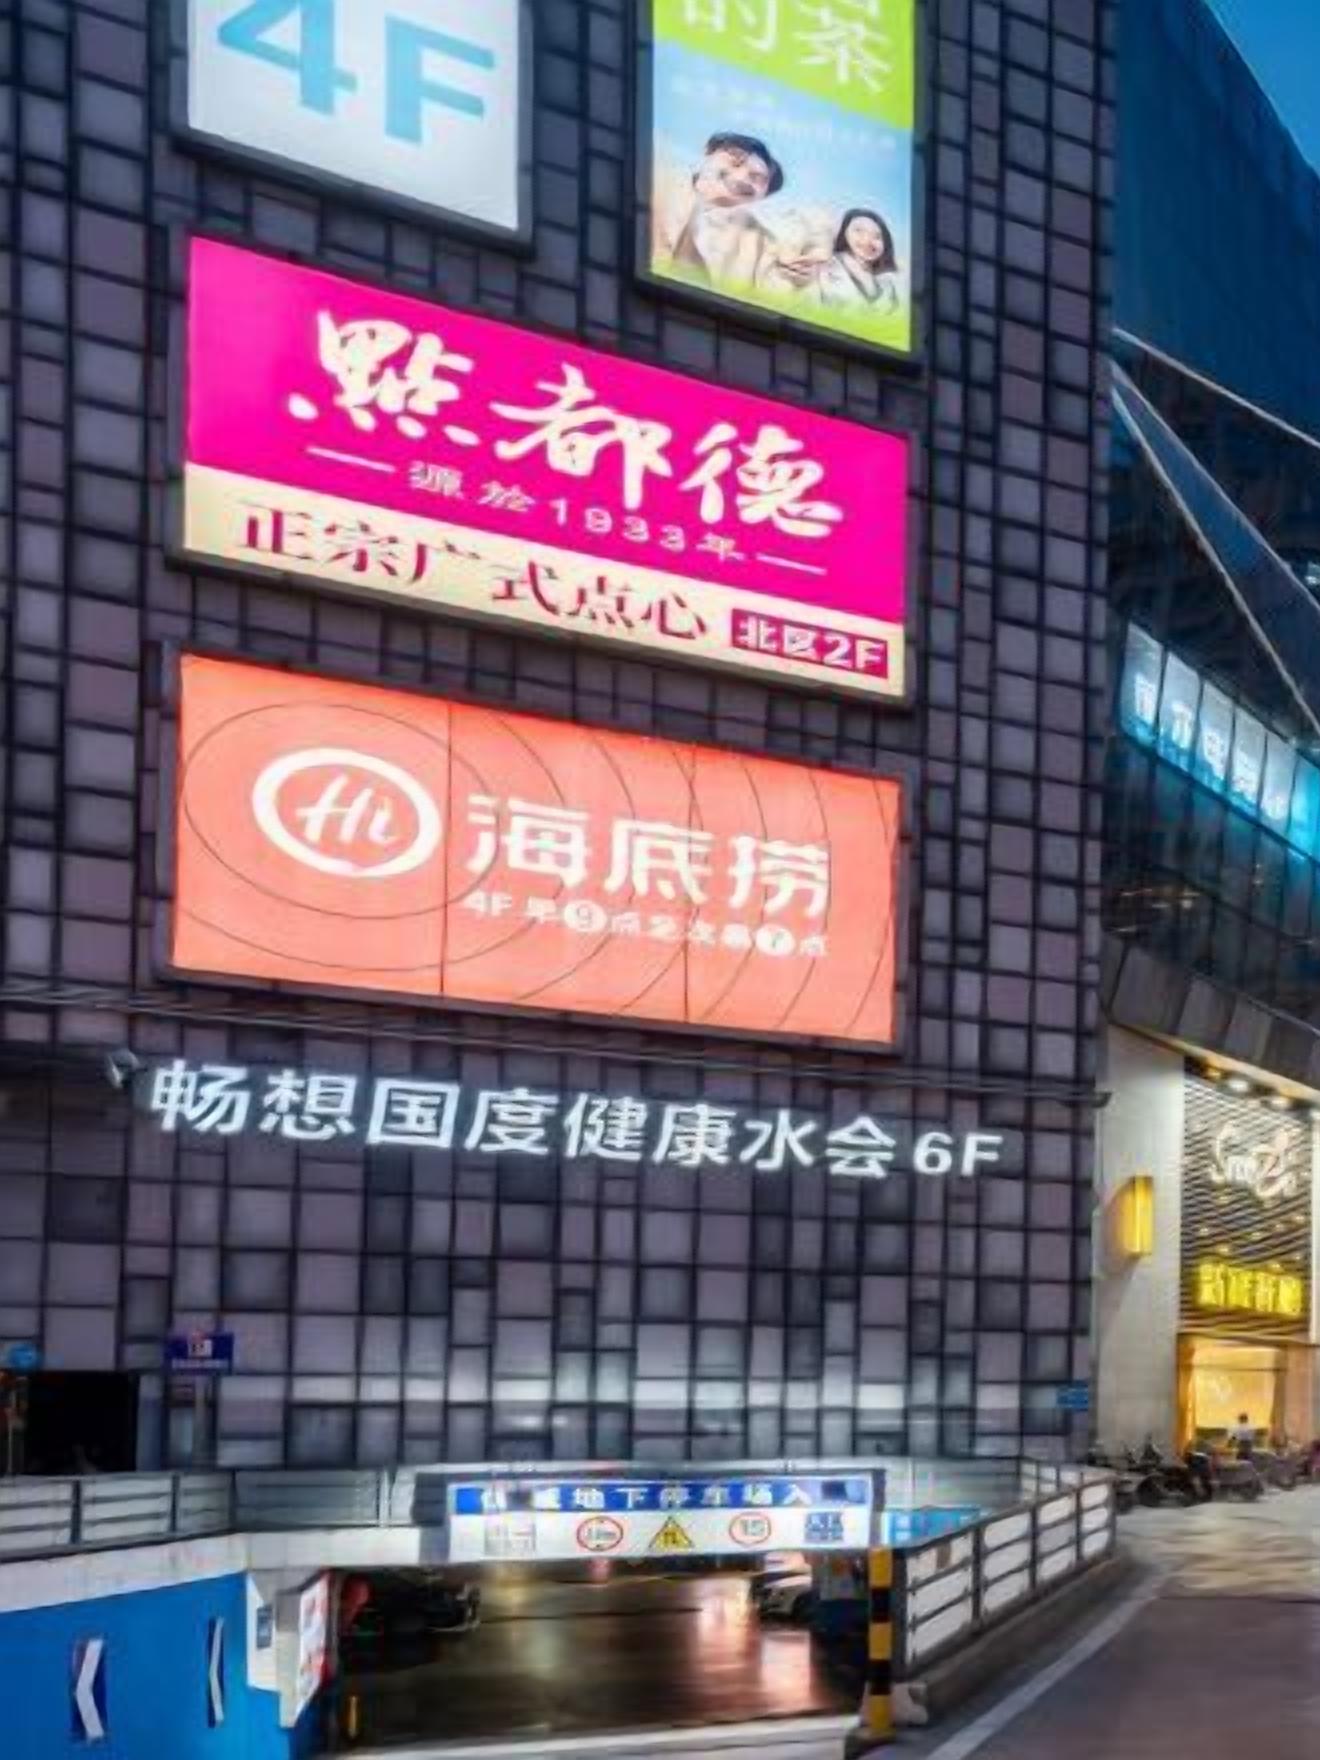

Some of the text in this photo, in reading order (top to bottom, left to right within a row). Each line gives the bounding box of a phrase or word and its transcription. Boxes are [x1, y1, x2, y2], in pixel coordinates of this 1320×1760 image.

[217, 0, 495, 144] 4F
[287, 309, 843, 537] 點都德
[238, 503, 706, 640] 正宗广式点心
[466, 794, 830, 918] 海底捞
[148, 1057, 897, 1179] 畅想国度健康水会
[912, 1130, 1004, 1178] 6F
